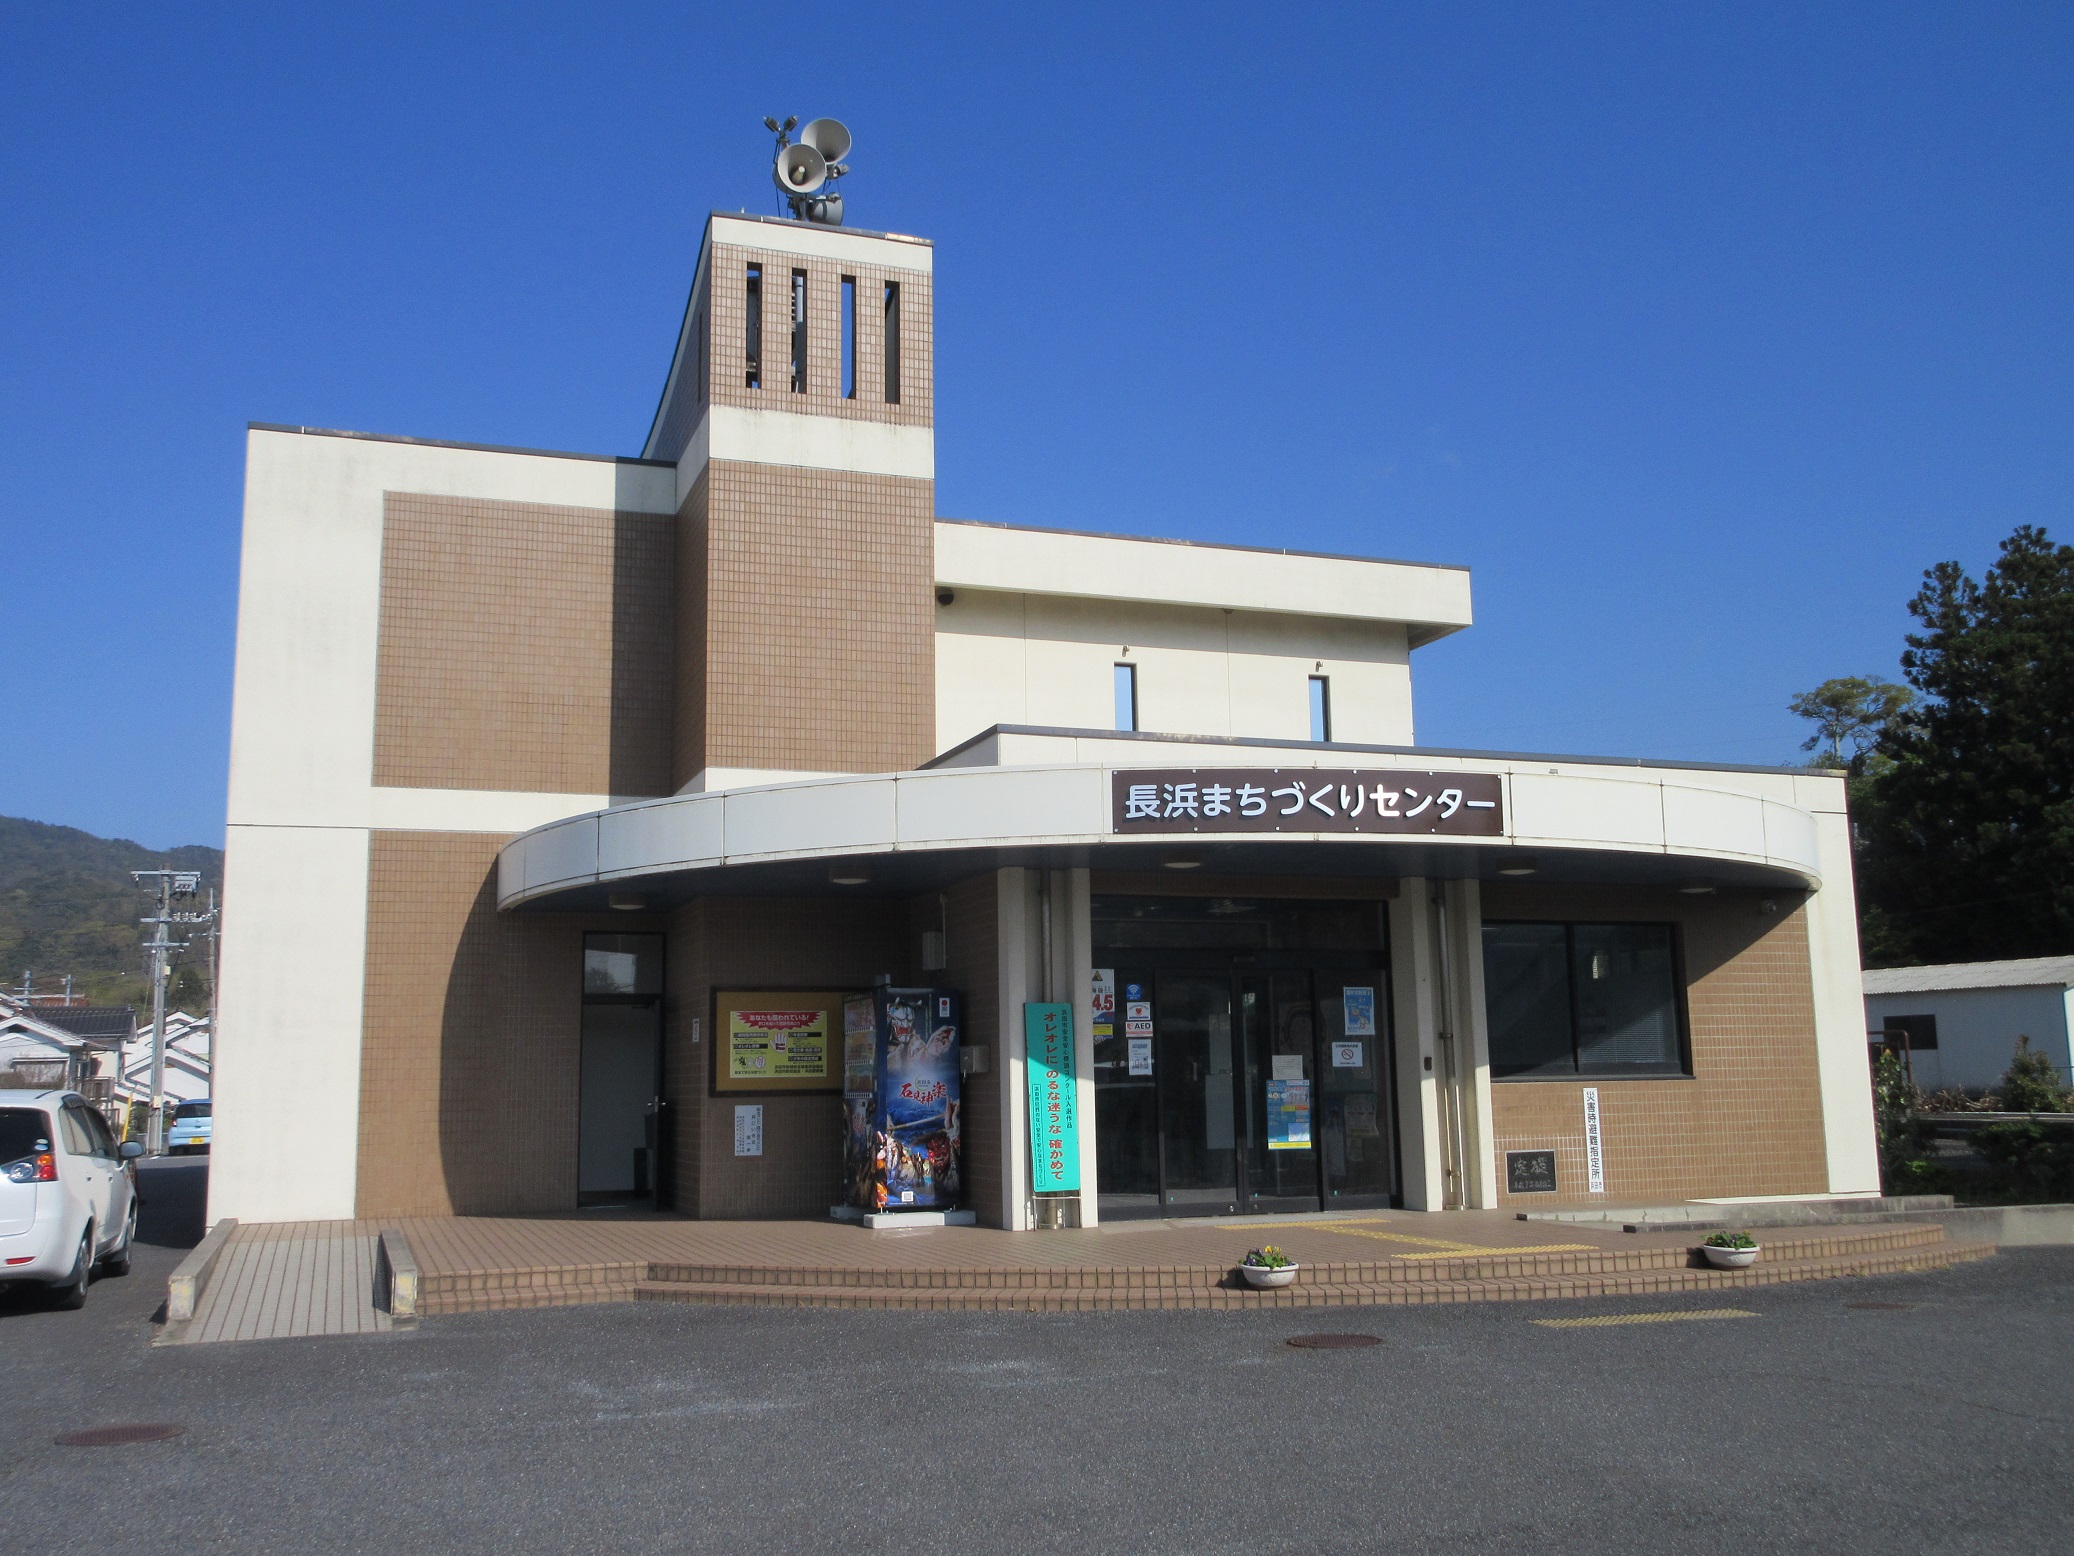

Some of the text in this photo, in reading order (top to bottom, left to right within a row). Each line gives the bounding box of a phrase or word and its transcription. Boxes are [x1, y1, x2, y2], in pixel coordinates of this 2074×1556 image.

[1125, 781, 1496, 819] 長浜まちづくりセンター
[1092, 994, 1113, 1011] 4.5
[899, 1081, 947, 1106] 石見神楽
[1586, 1090, 1601, 1180] 災害時避難指定所
